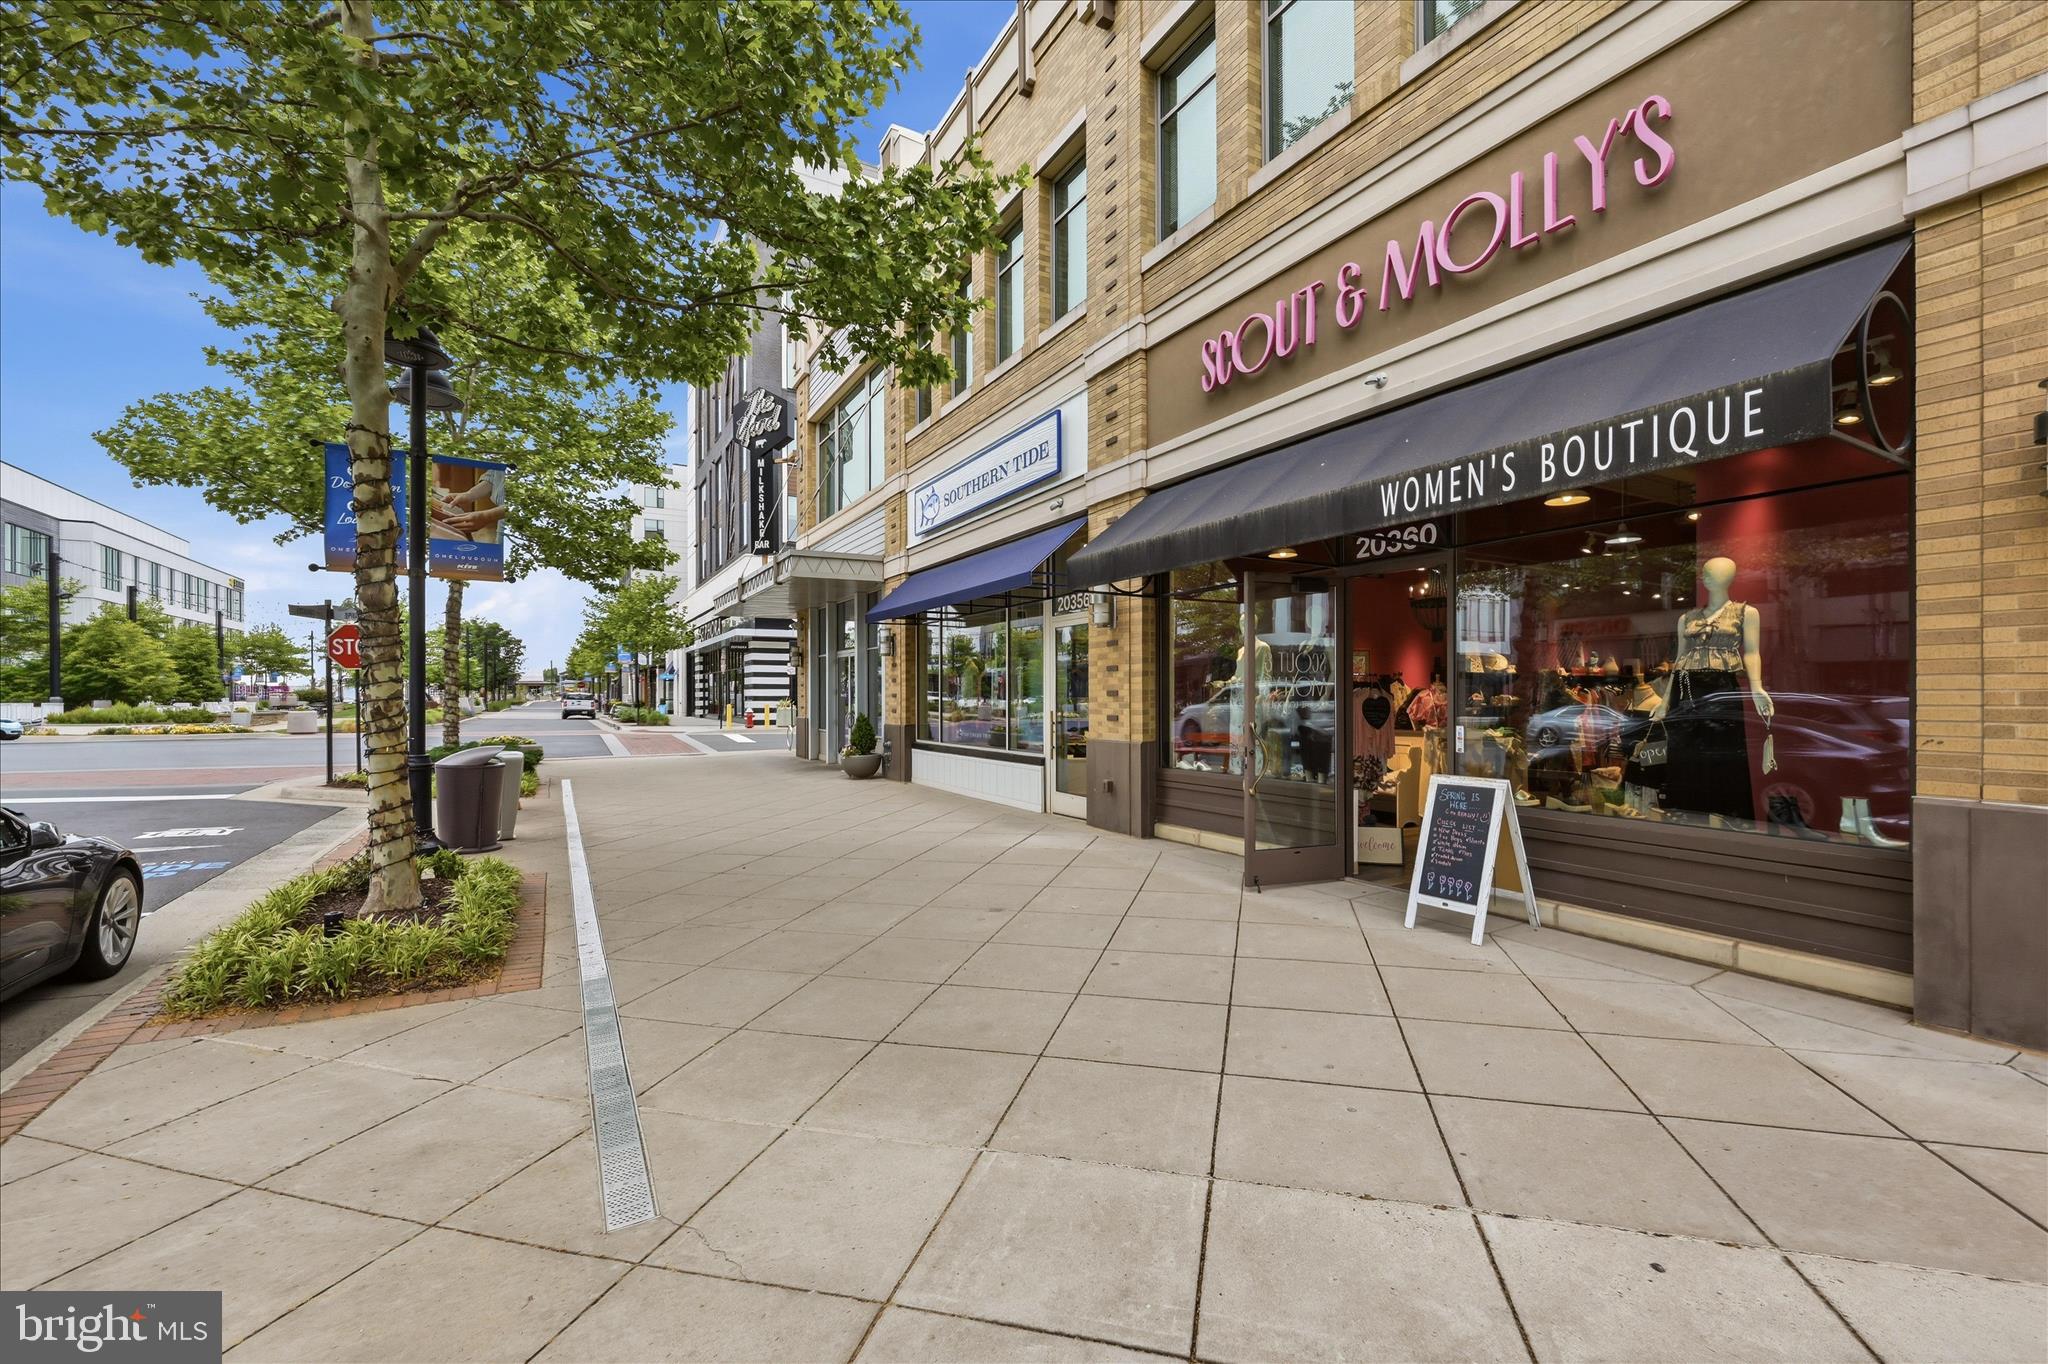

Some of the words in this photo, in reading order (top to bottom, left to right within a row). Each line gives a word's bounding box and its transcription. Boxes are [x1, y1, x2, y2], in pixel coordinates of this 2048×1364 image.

[1202, 280, 1325, 392] SCOUT
[1336, 262, 1367, 328] &
[1379, 95, 1675, 312] MOLLY'S
[743, 389, 775, 417] The
[1380, 451, 1516, 517] WOMEN'S
[1540, 388, 1764, 483] BOUTIQUE
[944, 460, 1010, 507] SOUTHERN
[1013, 440, 1050, 473] TIDE
[754, 540, 770, 549] BAR
[1356, 522, 1437, 559] 20360
[1057, 592, 1090, 612] 20356
[332, 638, 361, 656] ST
[1471, 793, 1480, 802] IS
